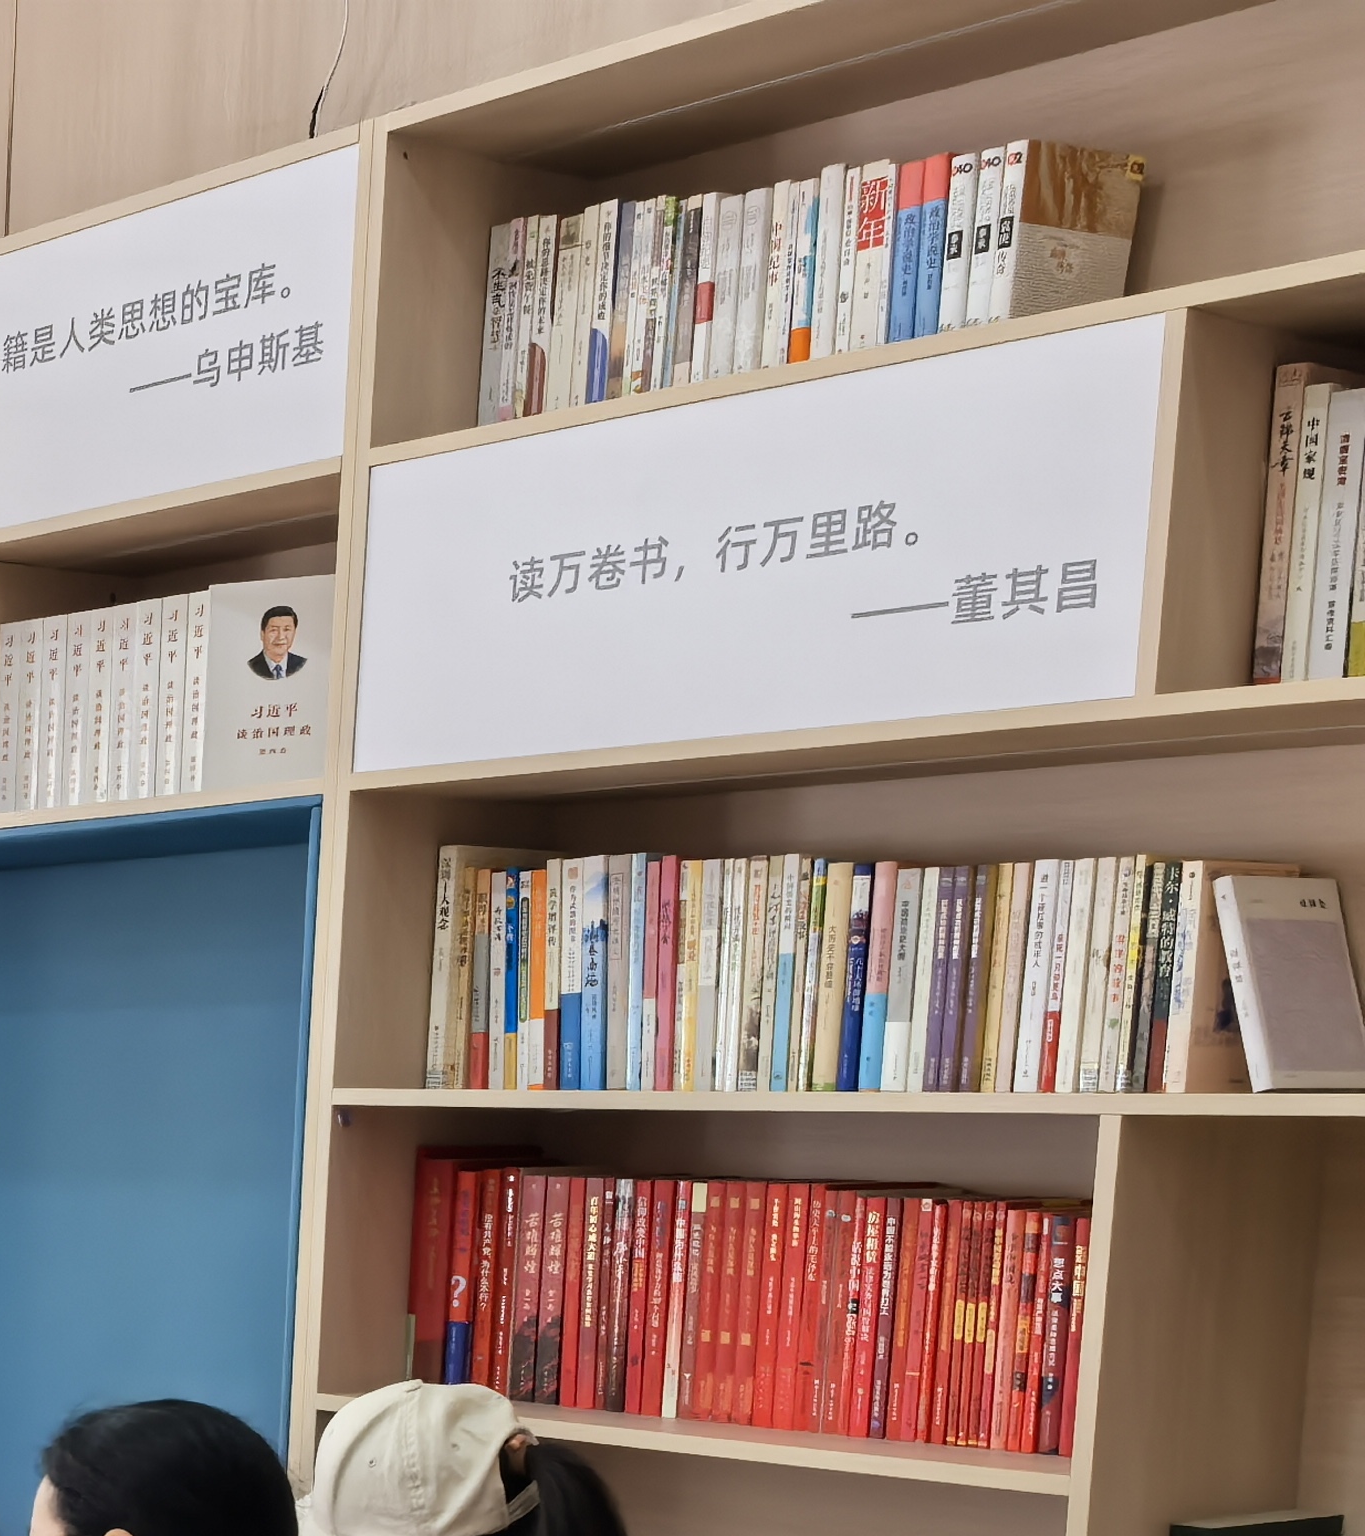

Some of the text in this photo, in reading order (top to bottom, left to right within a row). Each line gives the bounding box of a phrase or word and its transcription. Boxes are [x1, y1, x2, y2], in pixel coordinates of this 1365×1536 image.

[858, 178, 889, 249] 新年
[507, 500, 922, 603] 读万卷书，行万里路。
[26, 631, 36, 683] 习近平
[48, 629, 58, 680] 习近平
[73, 625, 82, 677] 习近平
[96, 619, 106, 672] 习近平
[119, 618, 129, 671] 习近平
[142, 612, 153, 666] 习近平
[168, 609, 179, 663] 习近平
[194, 604, 204, 658] 习近平
[4, 634, 14, 687] 习近平
[236, 725, 311, 740] 谈治国理政
[251, 702, 298, 719] 习近平
[523, 1212, 540, 1275] 苦难辉煌
[547, 1212, 565, 1275] 苦难辉煌
